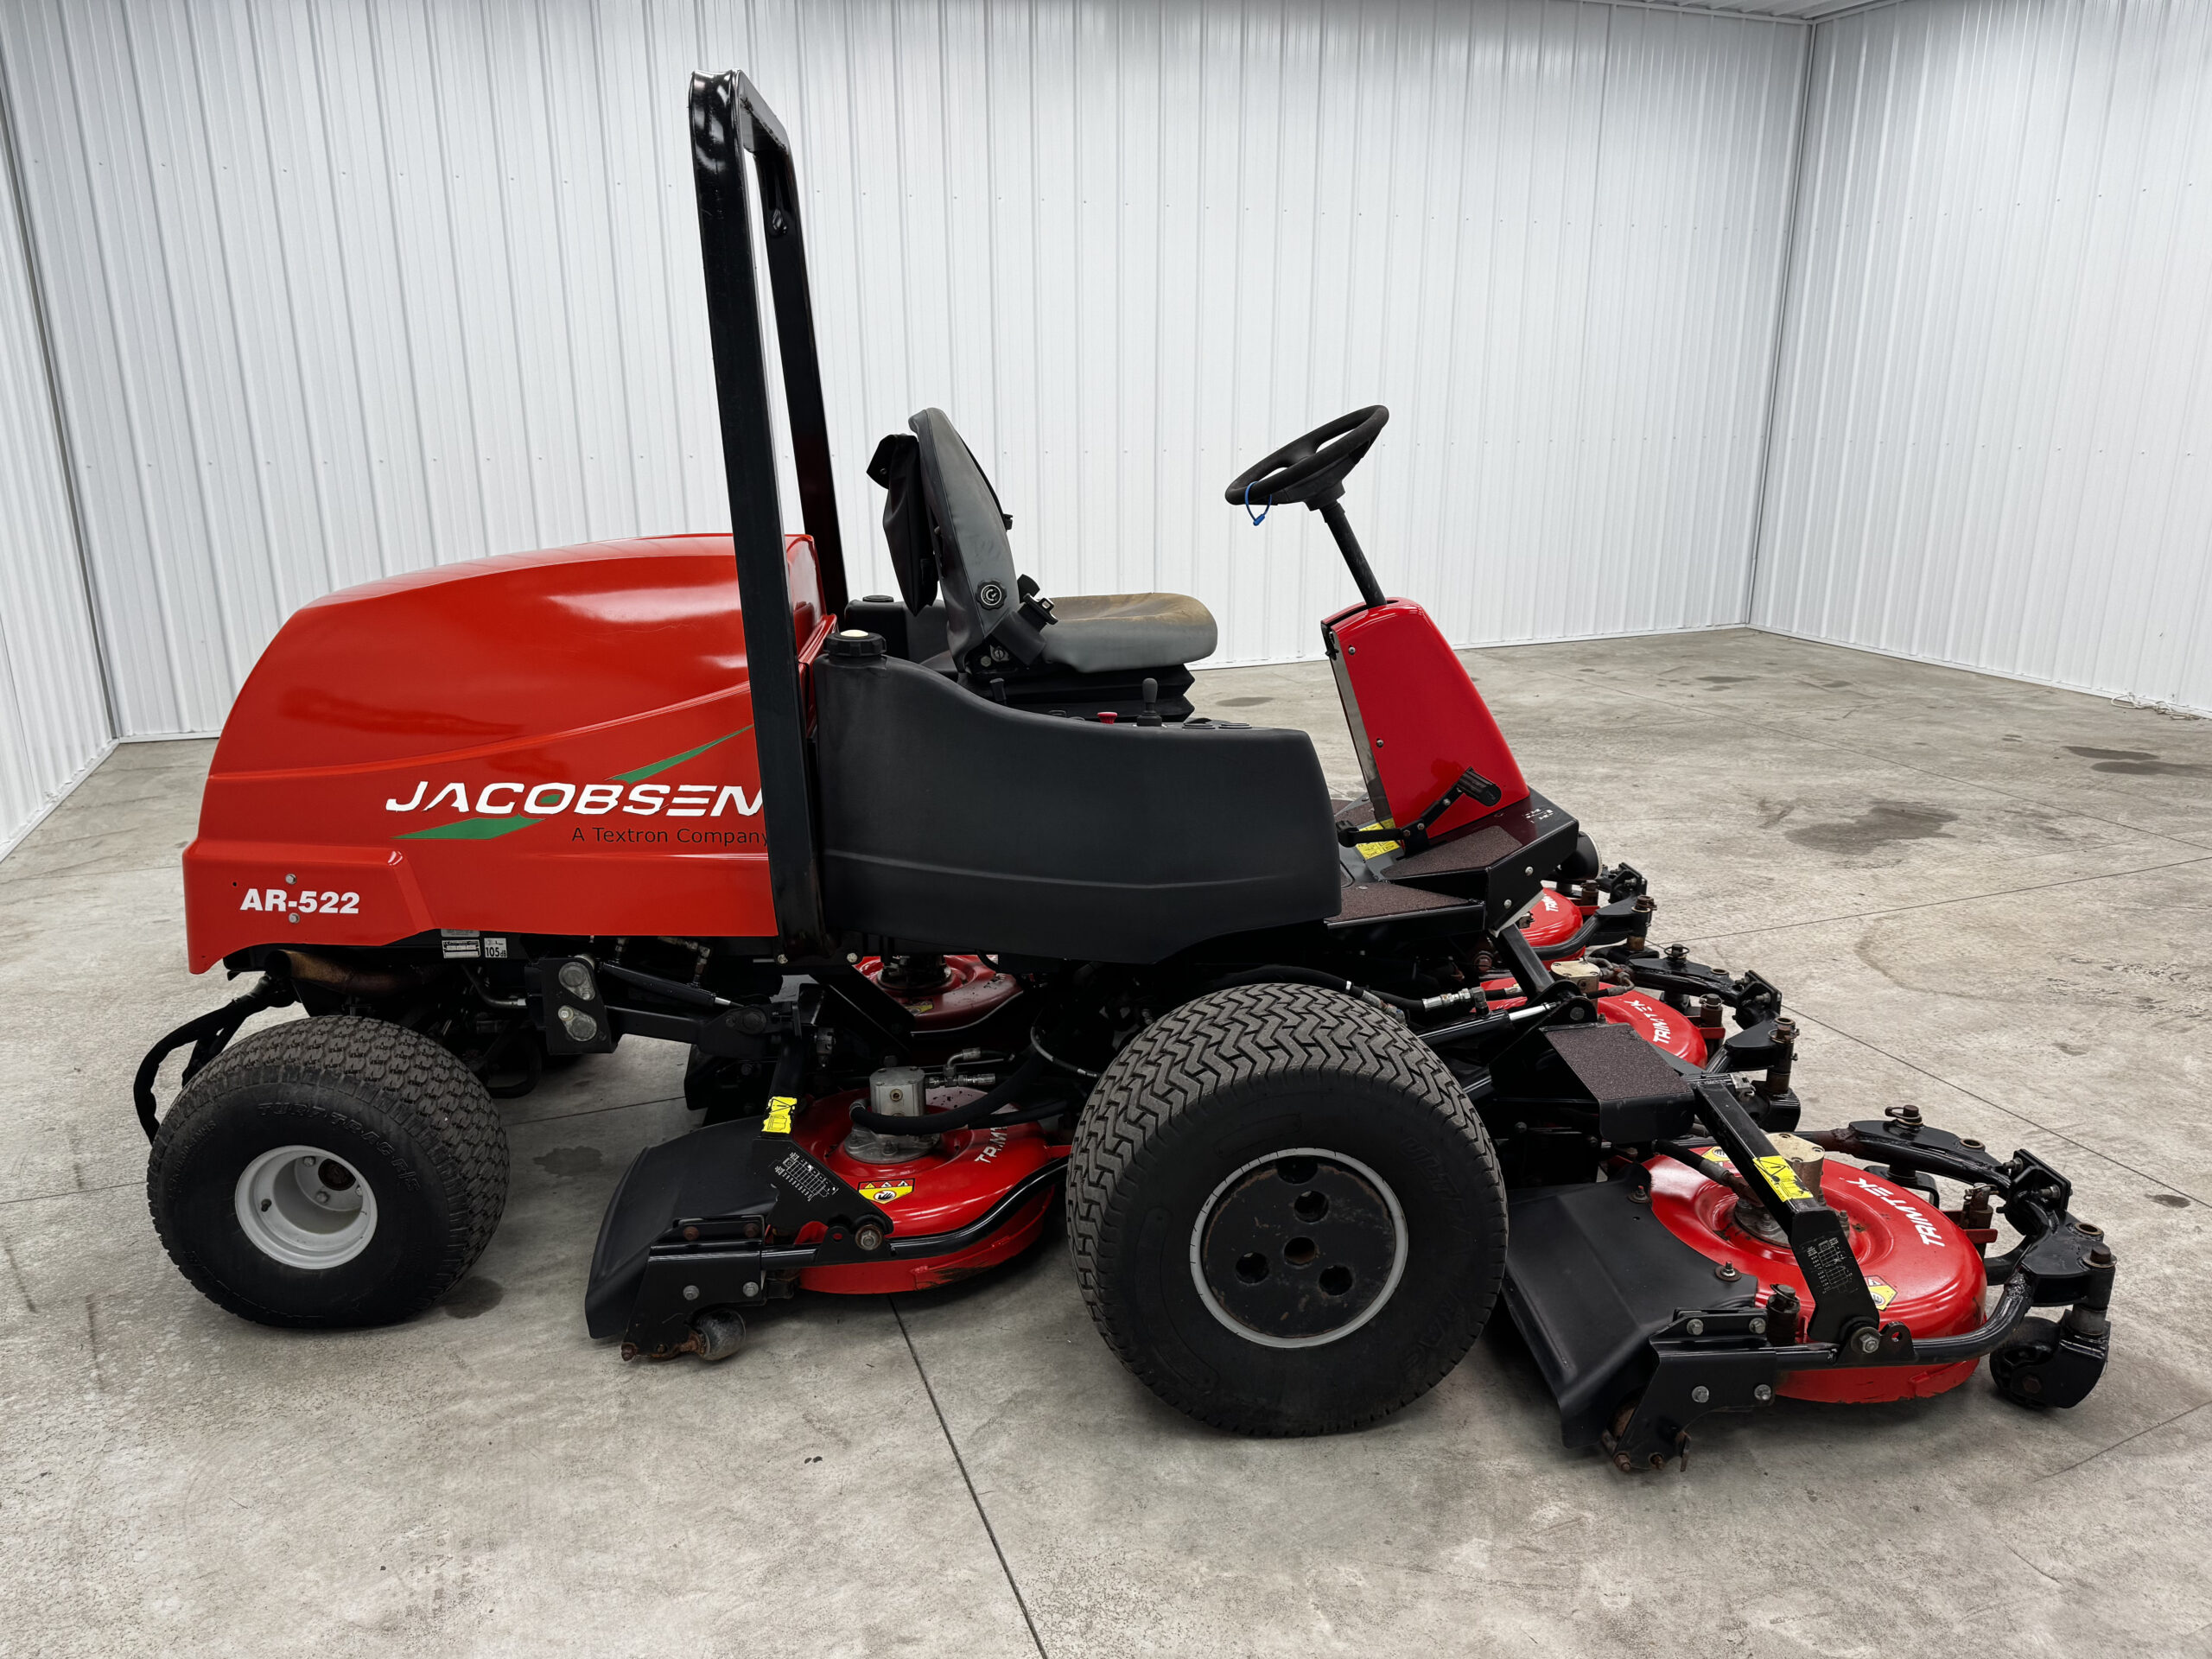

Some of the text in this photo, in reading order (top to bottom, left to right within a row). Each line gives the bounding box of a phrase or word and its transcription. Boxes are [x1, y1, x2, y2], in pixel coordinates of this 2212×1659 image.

[385, 780, 763, 817] JACOBSEN
[571, 827, 768, 847] A Textron Company
[239, 888, 360, 914] AR-522
[486, 946, 500, 957] 105
[1846, 1177, 1946, 1247] TRIMTEK
